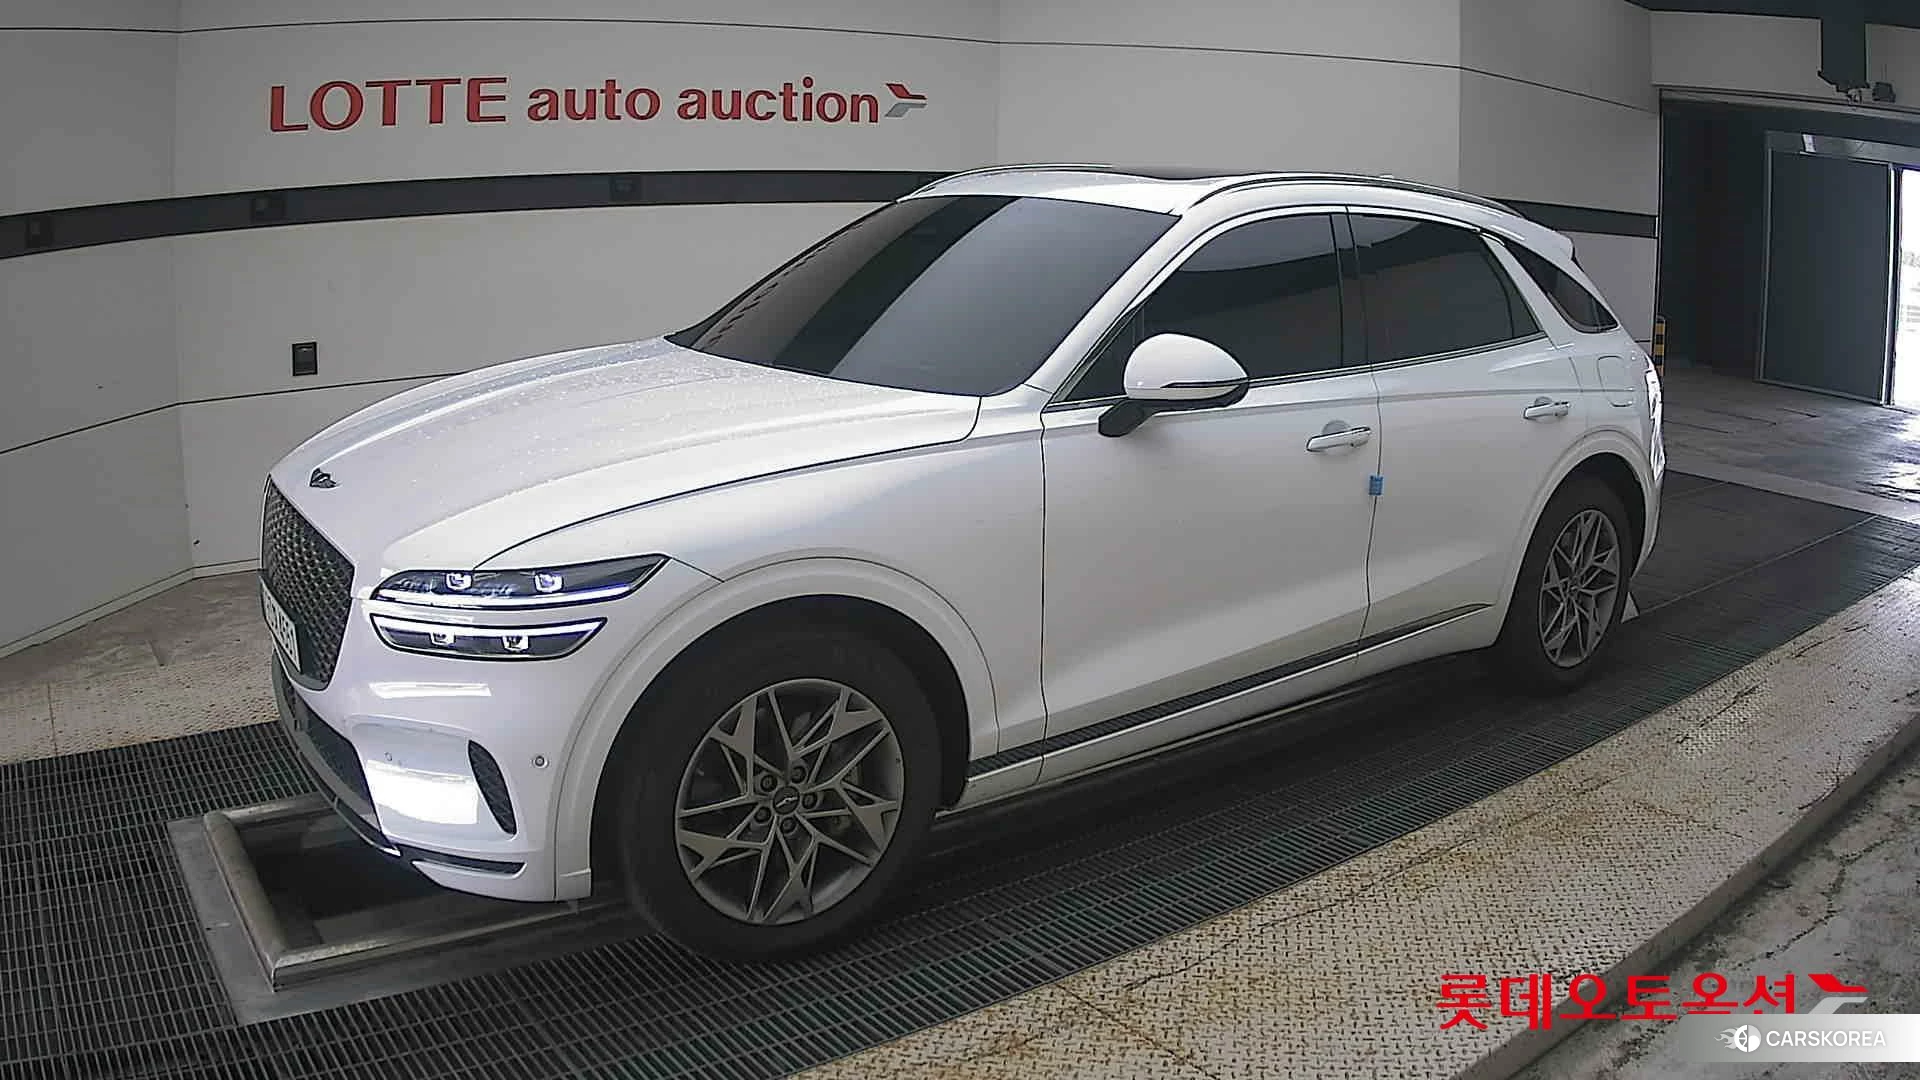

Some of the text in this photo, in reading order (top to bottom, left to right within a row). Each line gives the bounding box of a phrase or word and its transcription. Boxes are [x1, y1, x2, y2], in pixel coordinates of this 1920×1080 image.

[269, 76, 880, 133] LOTTE auto auction
